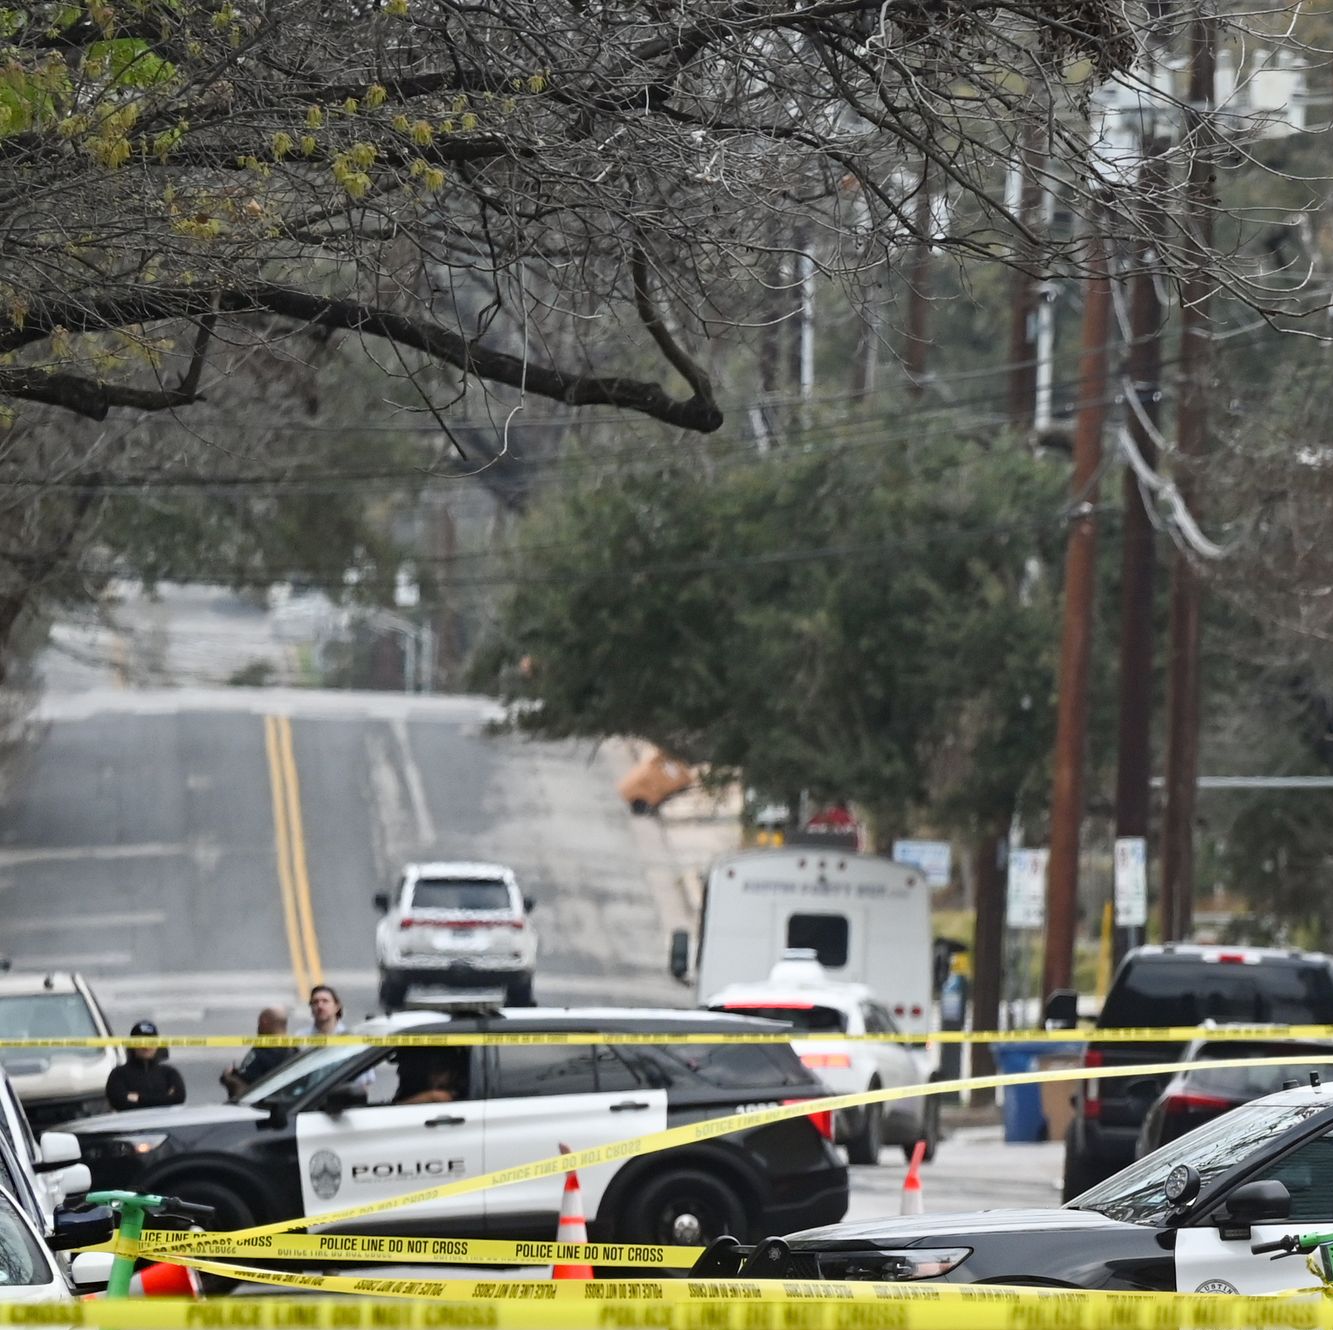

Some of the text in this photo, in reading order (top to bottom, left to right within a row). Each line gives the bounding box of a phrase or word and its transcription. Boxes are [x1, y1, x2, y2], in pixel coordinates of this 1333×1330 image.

[352, 1160, 466, 1178] POLICE
[320, 1237, 357, 1251] POLICE
[361, 1238, 384, 1252] LINE
[388, 1239, 403, 1253] DO
[407, 1239, 429, 1254] NOT
[432, 1240, 469, 1255] CROSS
[515, 1243, 664, 1262] POLICE LINE DO NOT CROSS
